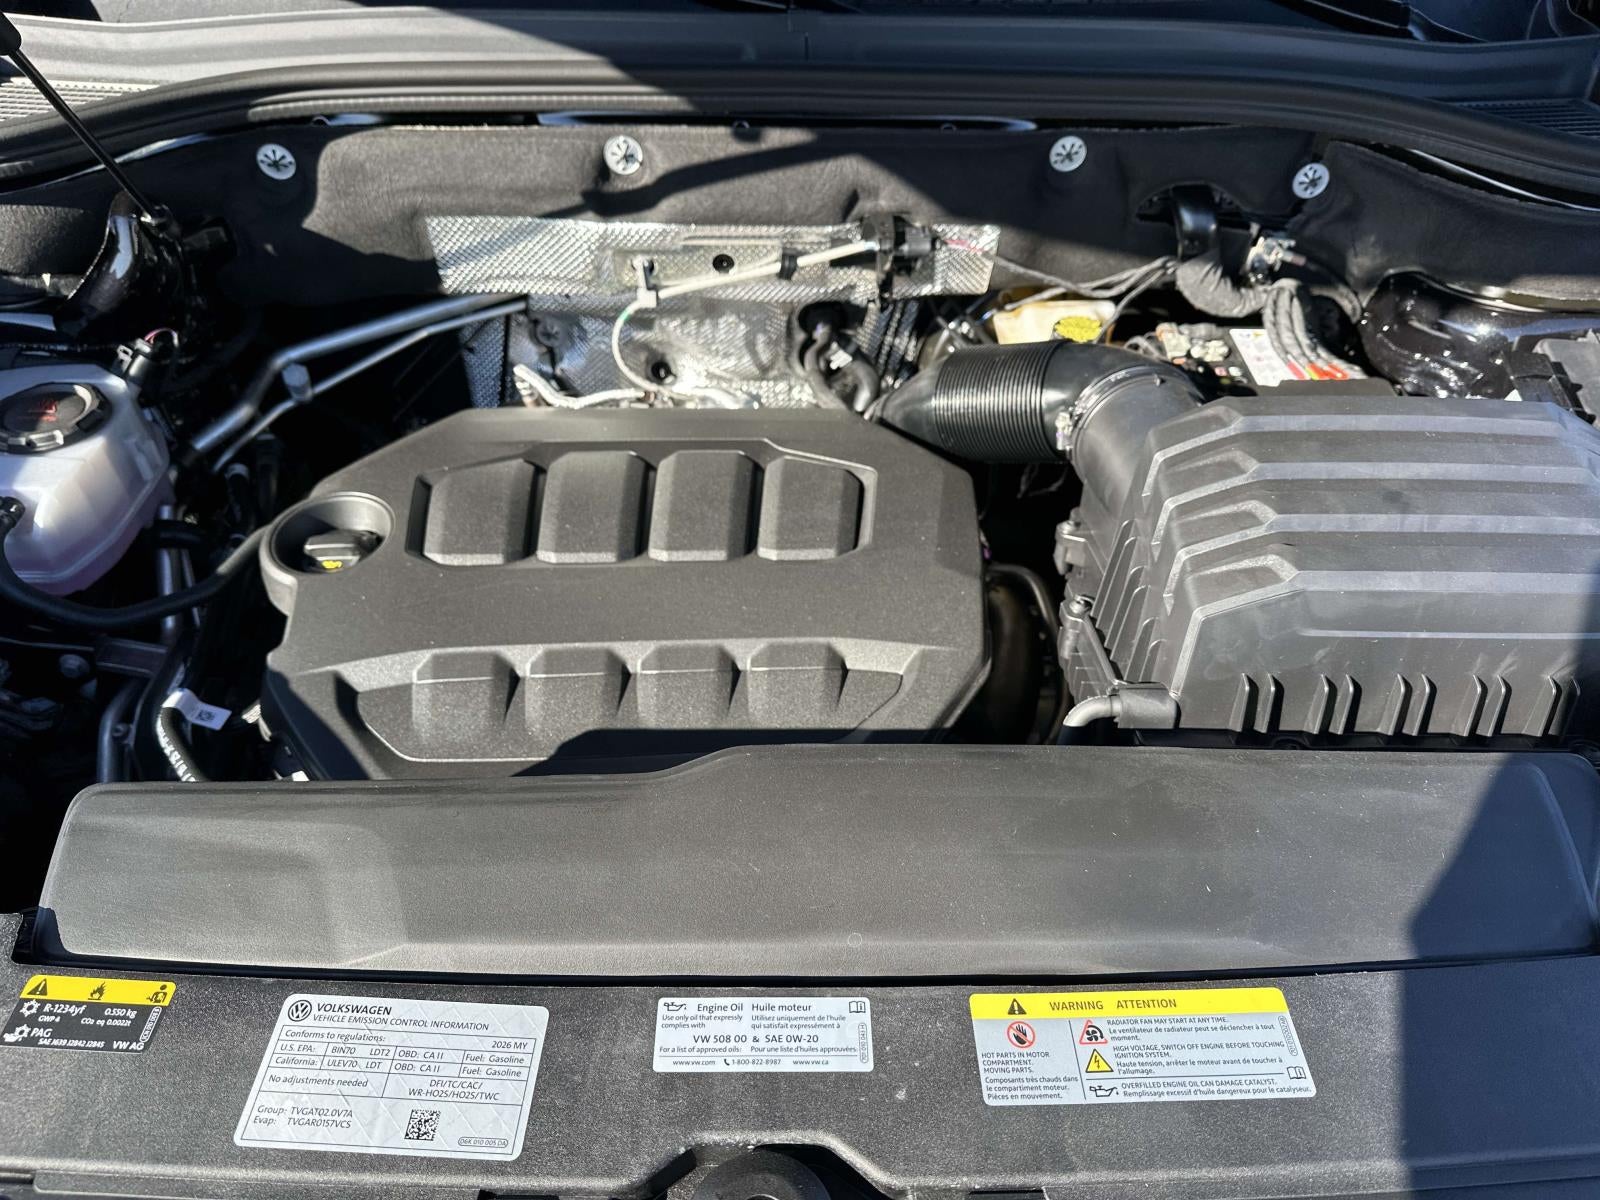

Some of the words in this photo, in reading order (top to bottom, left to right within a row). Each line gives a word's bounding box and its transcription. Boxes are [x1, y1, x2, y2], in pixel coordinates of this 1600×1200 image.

[698, 1003, 728, 1014] Engine
[730, 1003, 744, 1011] Oil
[752, 1003, 776, 1012] Huile
[778, 1004, 812, 1012] moteur
[1049, 1000, 1104, 1011] WARNING
[1116, 998, 1177, 1009] ATTENTION
[43, 1003, 87, 1016] R-1234yf
[104, 1008, 126, 1016] 0.550
[126, 1009, 138, 1019] kg
[316, 1002, 392, 1016] VOLKSWAGEN
[313, 1014, 346, 1022] VEHICLE
[348, 1016, 388, 1025] EMISSION
[389, 1018, 428, 1027] CONTROL
[430, 1020, 490, 1030] INFORMATION
[675, 1014, 688, 1022] only
[714, 1014, 742, 1022] expressly
[661, 1022, 690, 1030] complies
[790, 1022, 834, 1030] expressément
[30, 1028, 53, 1038] PAG
[285, 1029, 324, 1038] Conforms
[326, 1031, 336, 1039] to
[336, 1032, 386, 1044] regulations:
[693, 1034, 711, 1043] VW
[714, 1034, 731, 1043] 508
[734, 1034, 747, 1043] 00
[764, 1034, 783, 1043] SAE
[786, 1034, 818, 1043] 0W-20
[113, 1040, 130, 1049] VW
[129, 1042, 144, 1050] AG
[280, 1043, 296, 1052] U.S.
[297, 1044, 316, 1052] EPA:
[492, 1040, 512, 1048] 2026
[513, 1042, 528, 1050] MY
[332, 1046, 356, 1054] BIN70
[370, 1048, 390, 1056] LDT2
[398, 1050, 420, 1058] OBD:
[423, 1051, 435, 1059] CA
[696, 1046, 727, 1056] approved
[276, 1056, 318, 1066] California:
[327, 1059, 358, 1068] ULEV70
[365, 1061, 382, 1069] LDT
[466, 1054, 486, 1062] Fuel:
[488, 1055, 525, 1064] Gasoline
[394, 1062, 416, 1072] OBD:
[420, 1064, 431, 1072] CA
[462, 1066, 482, 1075] Fuel:
[486, 1068, 522, 1077] Gasoline
[268, 1074, 282, 1083] No
[282, 1075, 335, 1086] adjustments
[337, 1078, 368, 1088] needed
[429, 1079, 483, 1090] DFI/TC/CAC/
[1124, 1090, 1164, 1098] Remplissage
[1217, 1088, 1250, 1096] dangereux
[257, 1105, 288, 1116] Group:
[254, 1116, 276, 1126] Evap:
